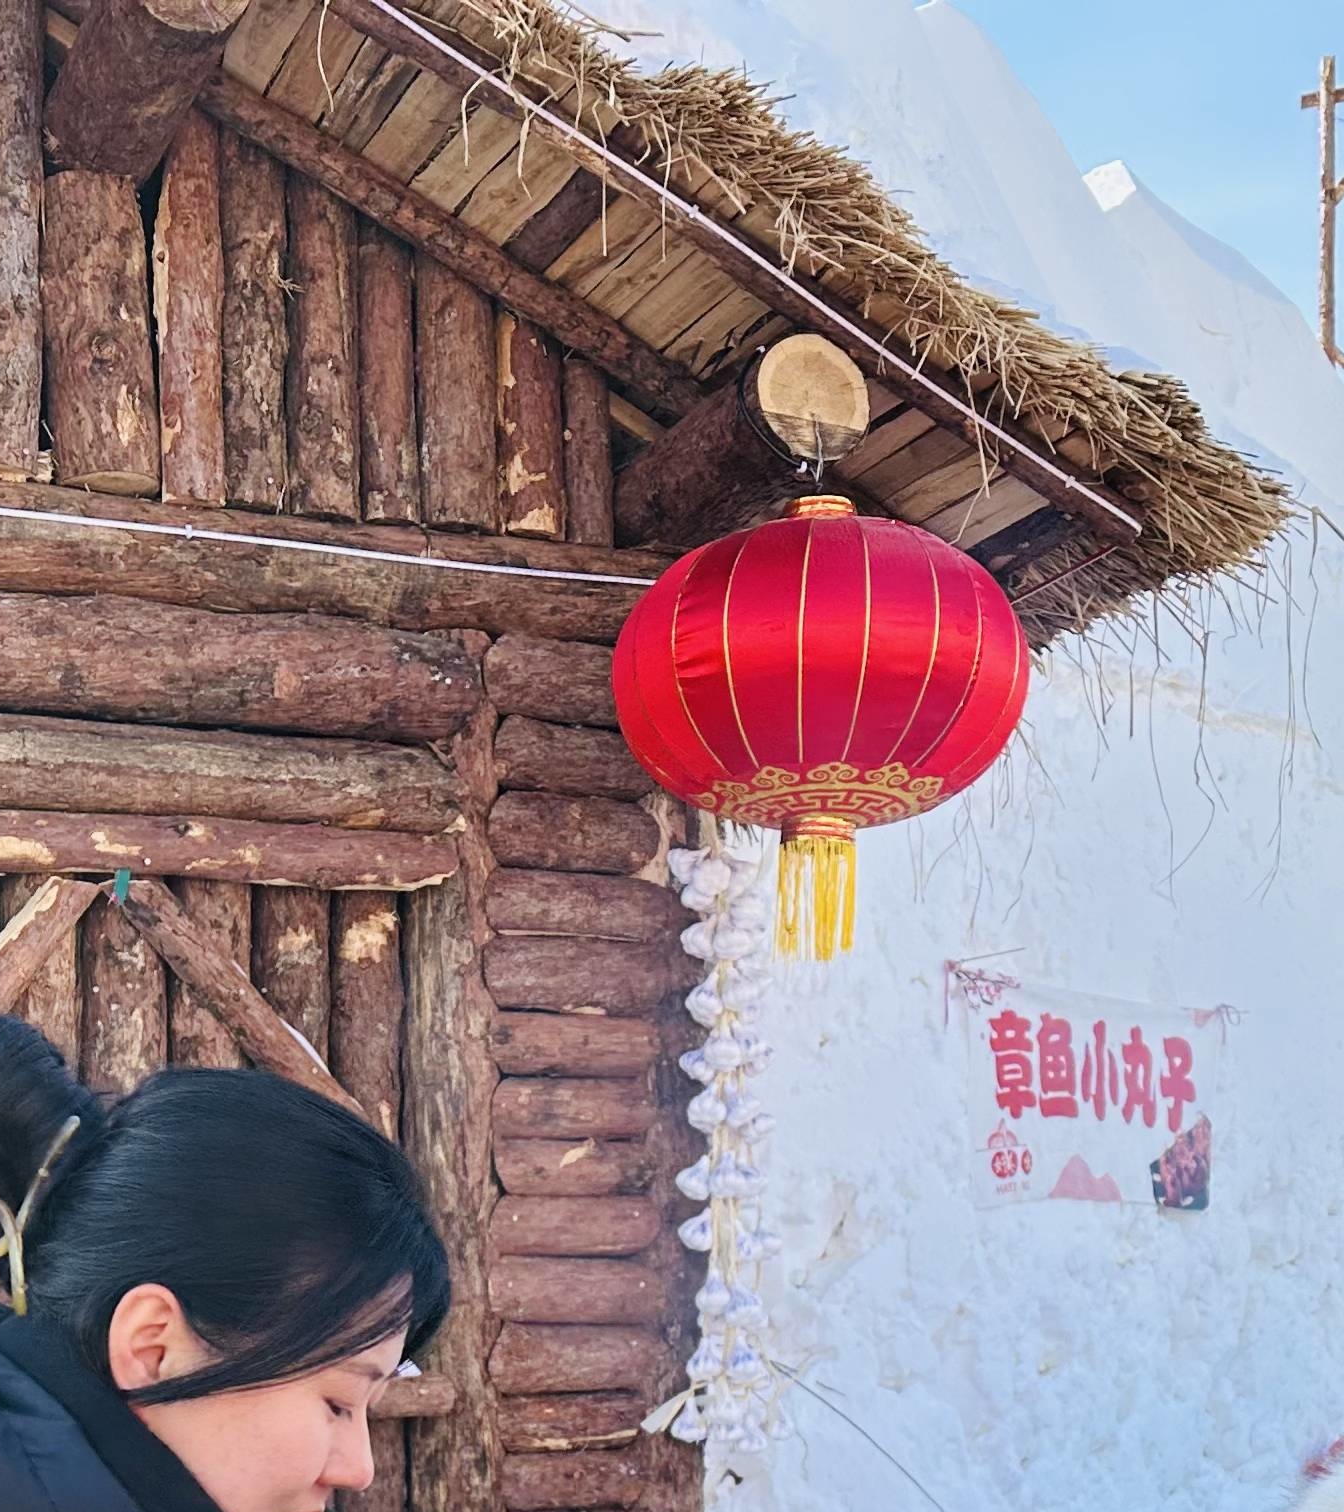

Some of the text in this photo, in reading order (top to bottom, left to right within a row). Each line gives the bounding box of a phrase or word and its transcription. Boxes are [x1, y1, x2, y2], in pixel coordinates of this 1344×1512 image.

[989, 1009, 1196, 1133] 章鱼小丸子
